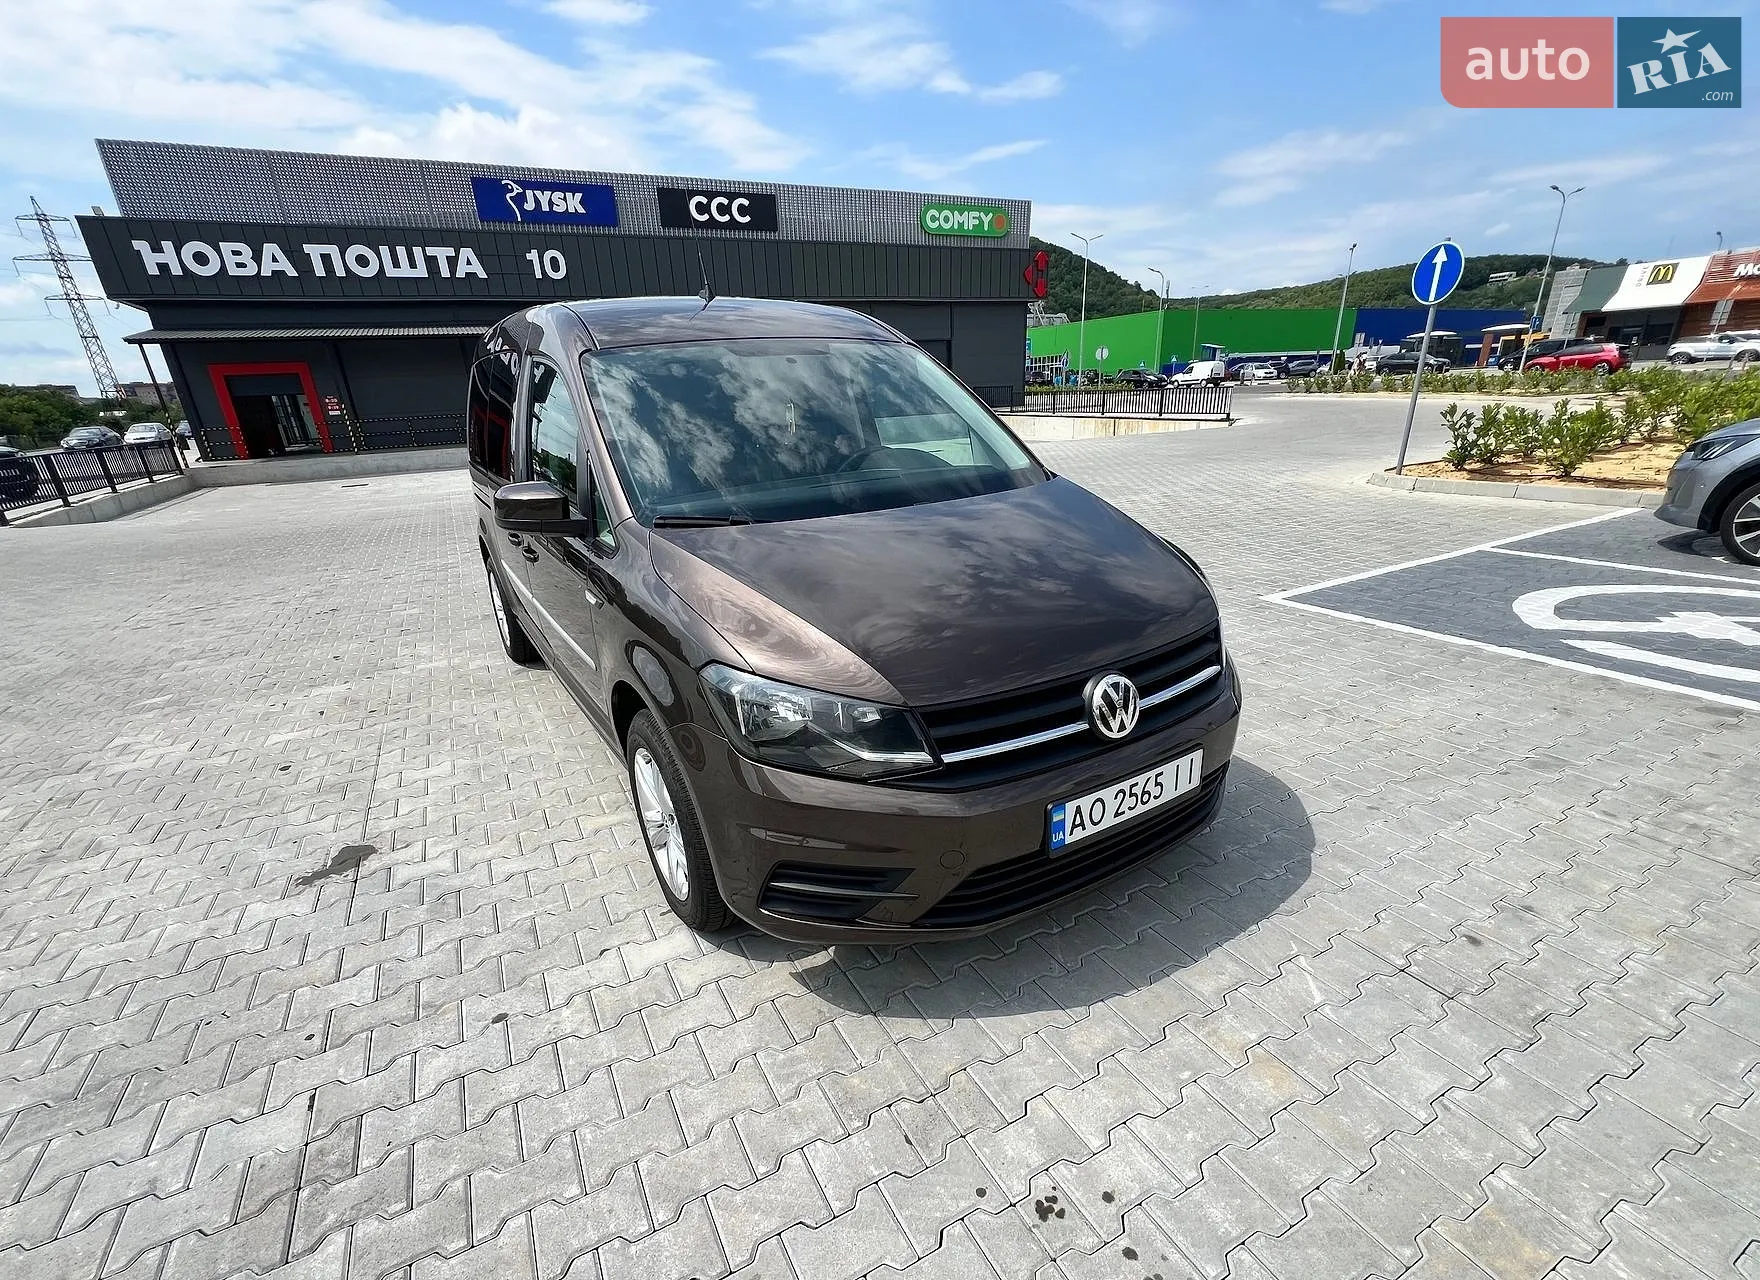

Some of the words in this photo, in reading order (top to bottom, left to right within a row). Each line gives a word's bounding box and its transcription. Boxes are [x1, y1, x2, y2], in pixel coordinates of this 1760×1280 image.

[523, 190, 586, 214] JYSK
[689, 195, 752, 223] CCC
[926, 209, 993, 231] COMFY
[131, 240, 299, 278] НОВА
[302, 243, 488, 279] ПОШТА
[526, 249, 567, 280] 10
[1068, 797, 1106, 837] AO
[1113, 771, 1164, 819] 2565
[1052, 831, 1065, 842] UA
